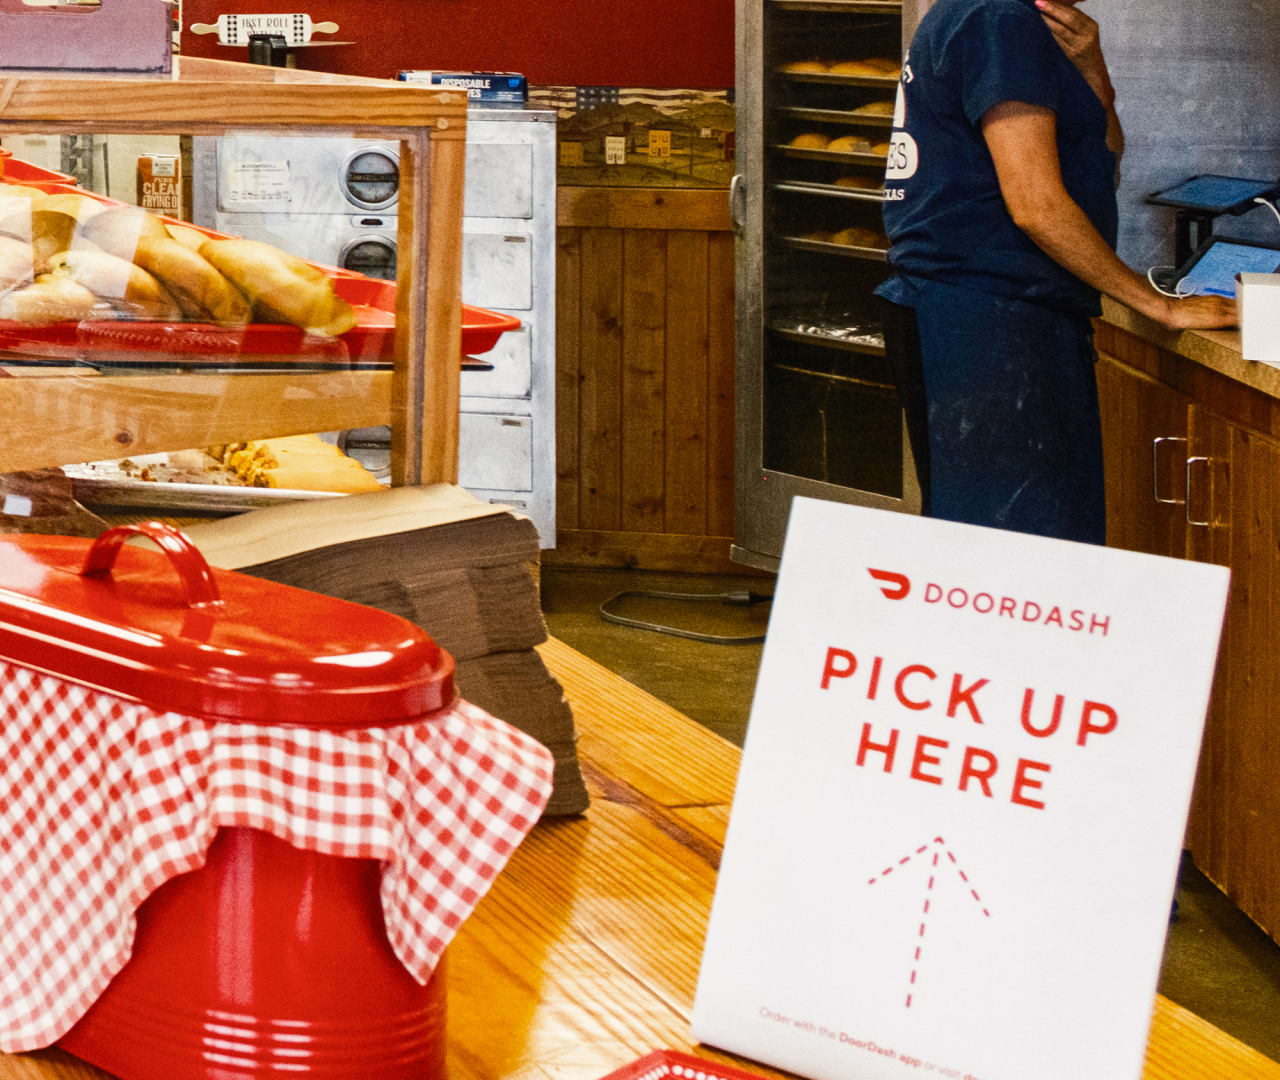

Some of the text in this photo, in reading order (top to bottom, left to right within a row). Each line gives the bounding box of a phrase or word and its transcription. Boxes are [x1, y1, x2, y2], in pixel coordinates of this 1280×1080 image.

[242, 17, 289, 28] JUST ROLL
[441, 78, 491, 89] DISPOSABLE
[925, 583, 1111, 636] DOORDASH
[819, 646, 1119, 748] PICK UP
[855, 722, 1052, 810] HERE
[760, 1006, 791, 1023] Order
[793, 1019, 816, 1034] with
[819, 1026, 837, 1040] the
[839, 1031, 896, 1058] DoorDash
[899, 1054, 922, 1069] app
